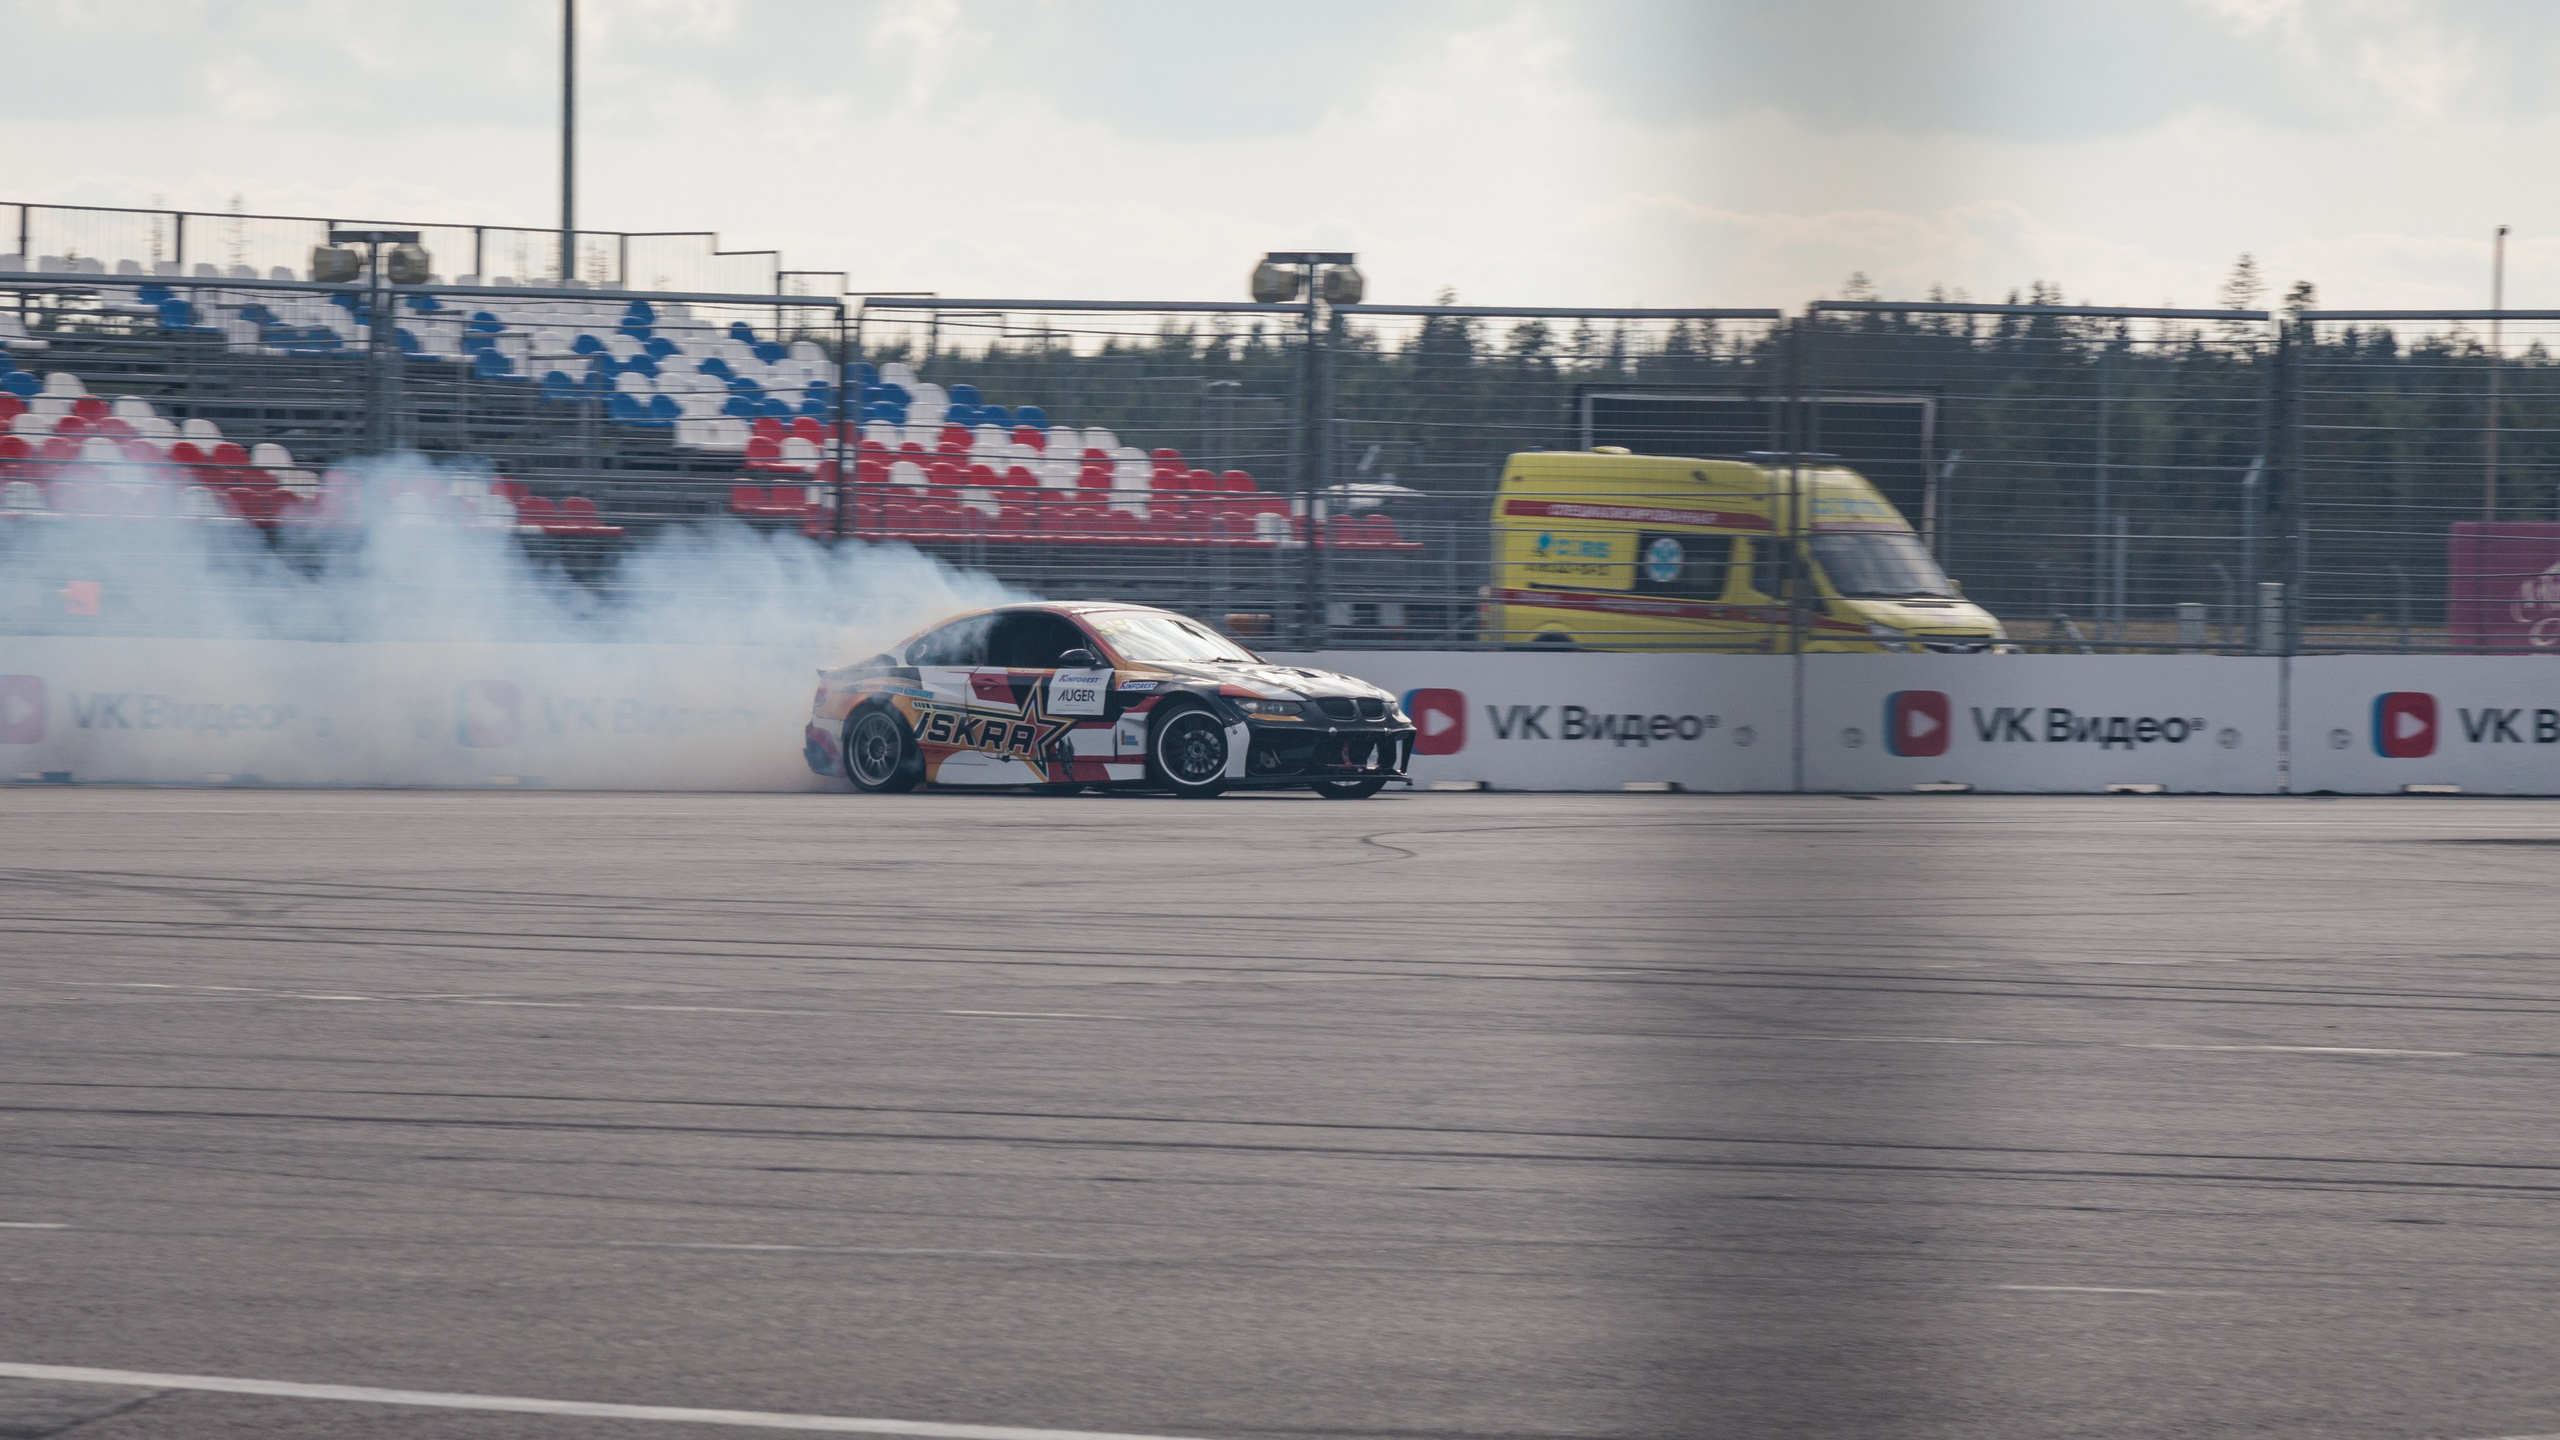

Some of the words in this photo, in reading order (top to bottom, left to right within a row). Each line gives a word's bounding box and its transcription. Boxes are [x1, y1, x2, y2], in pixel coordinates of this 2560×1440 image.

[1058, 674, 1100, 684] KINFOREST
[1058, 689, 1096, 702] AUGER
[1119, 680, 1156, 690] KINFOREST
[67, 692, 132, 729] VK
[1486, 704, 1551, 740] VK
[1970, 708, 2035, 742] VK
[2459, 709, 2523, 743] VK
[914, 711, 1036, 756] ISKRA
